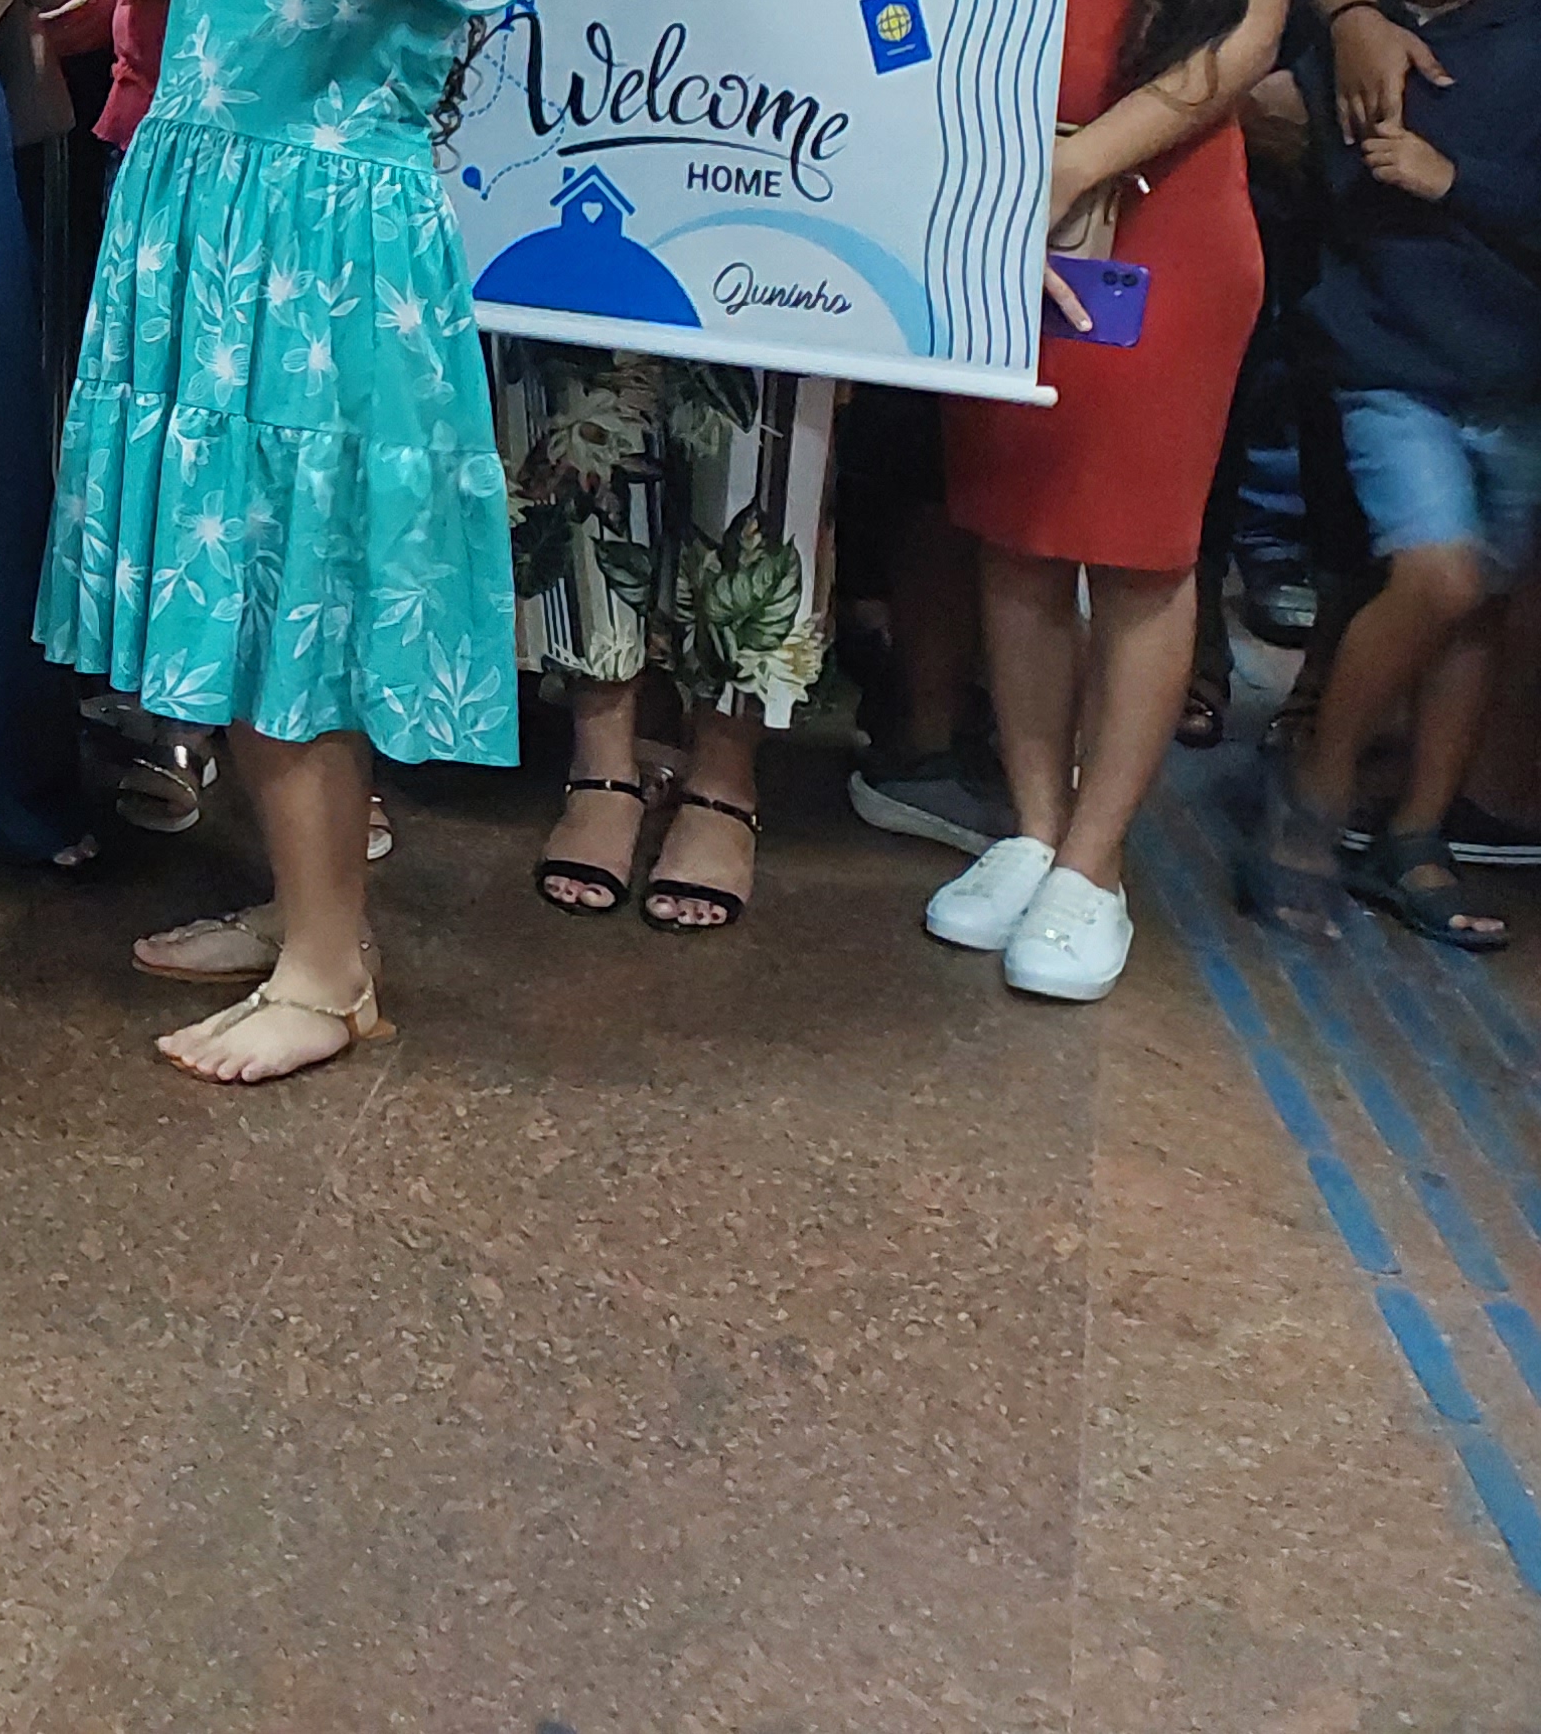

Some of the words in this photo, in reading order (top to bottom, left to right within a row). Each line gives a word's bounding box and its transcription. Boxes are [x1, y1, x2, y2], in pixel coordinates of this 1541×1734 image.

[465, 12, 849, 203] Welcome
[686, 162, 783, 198] HOME
[713, 262, 853, 316] Juninho
